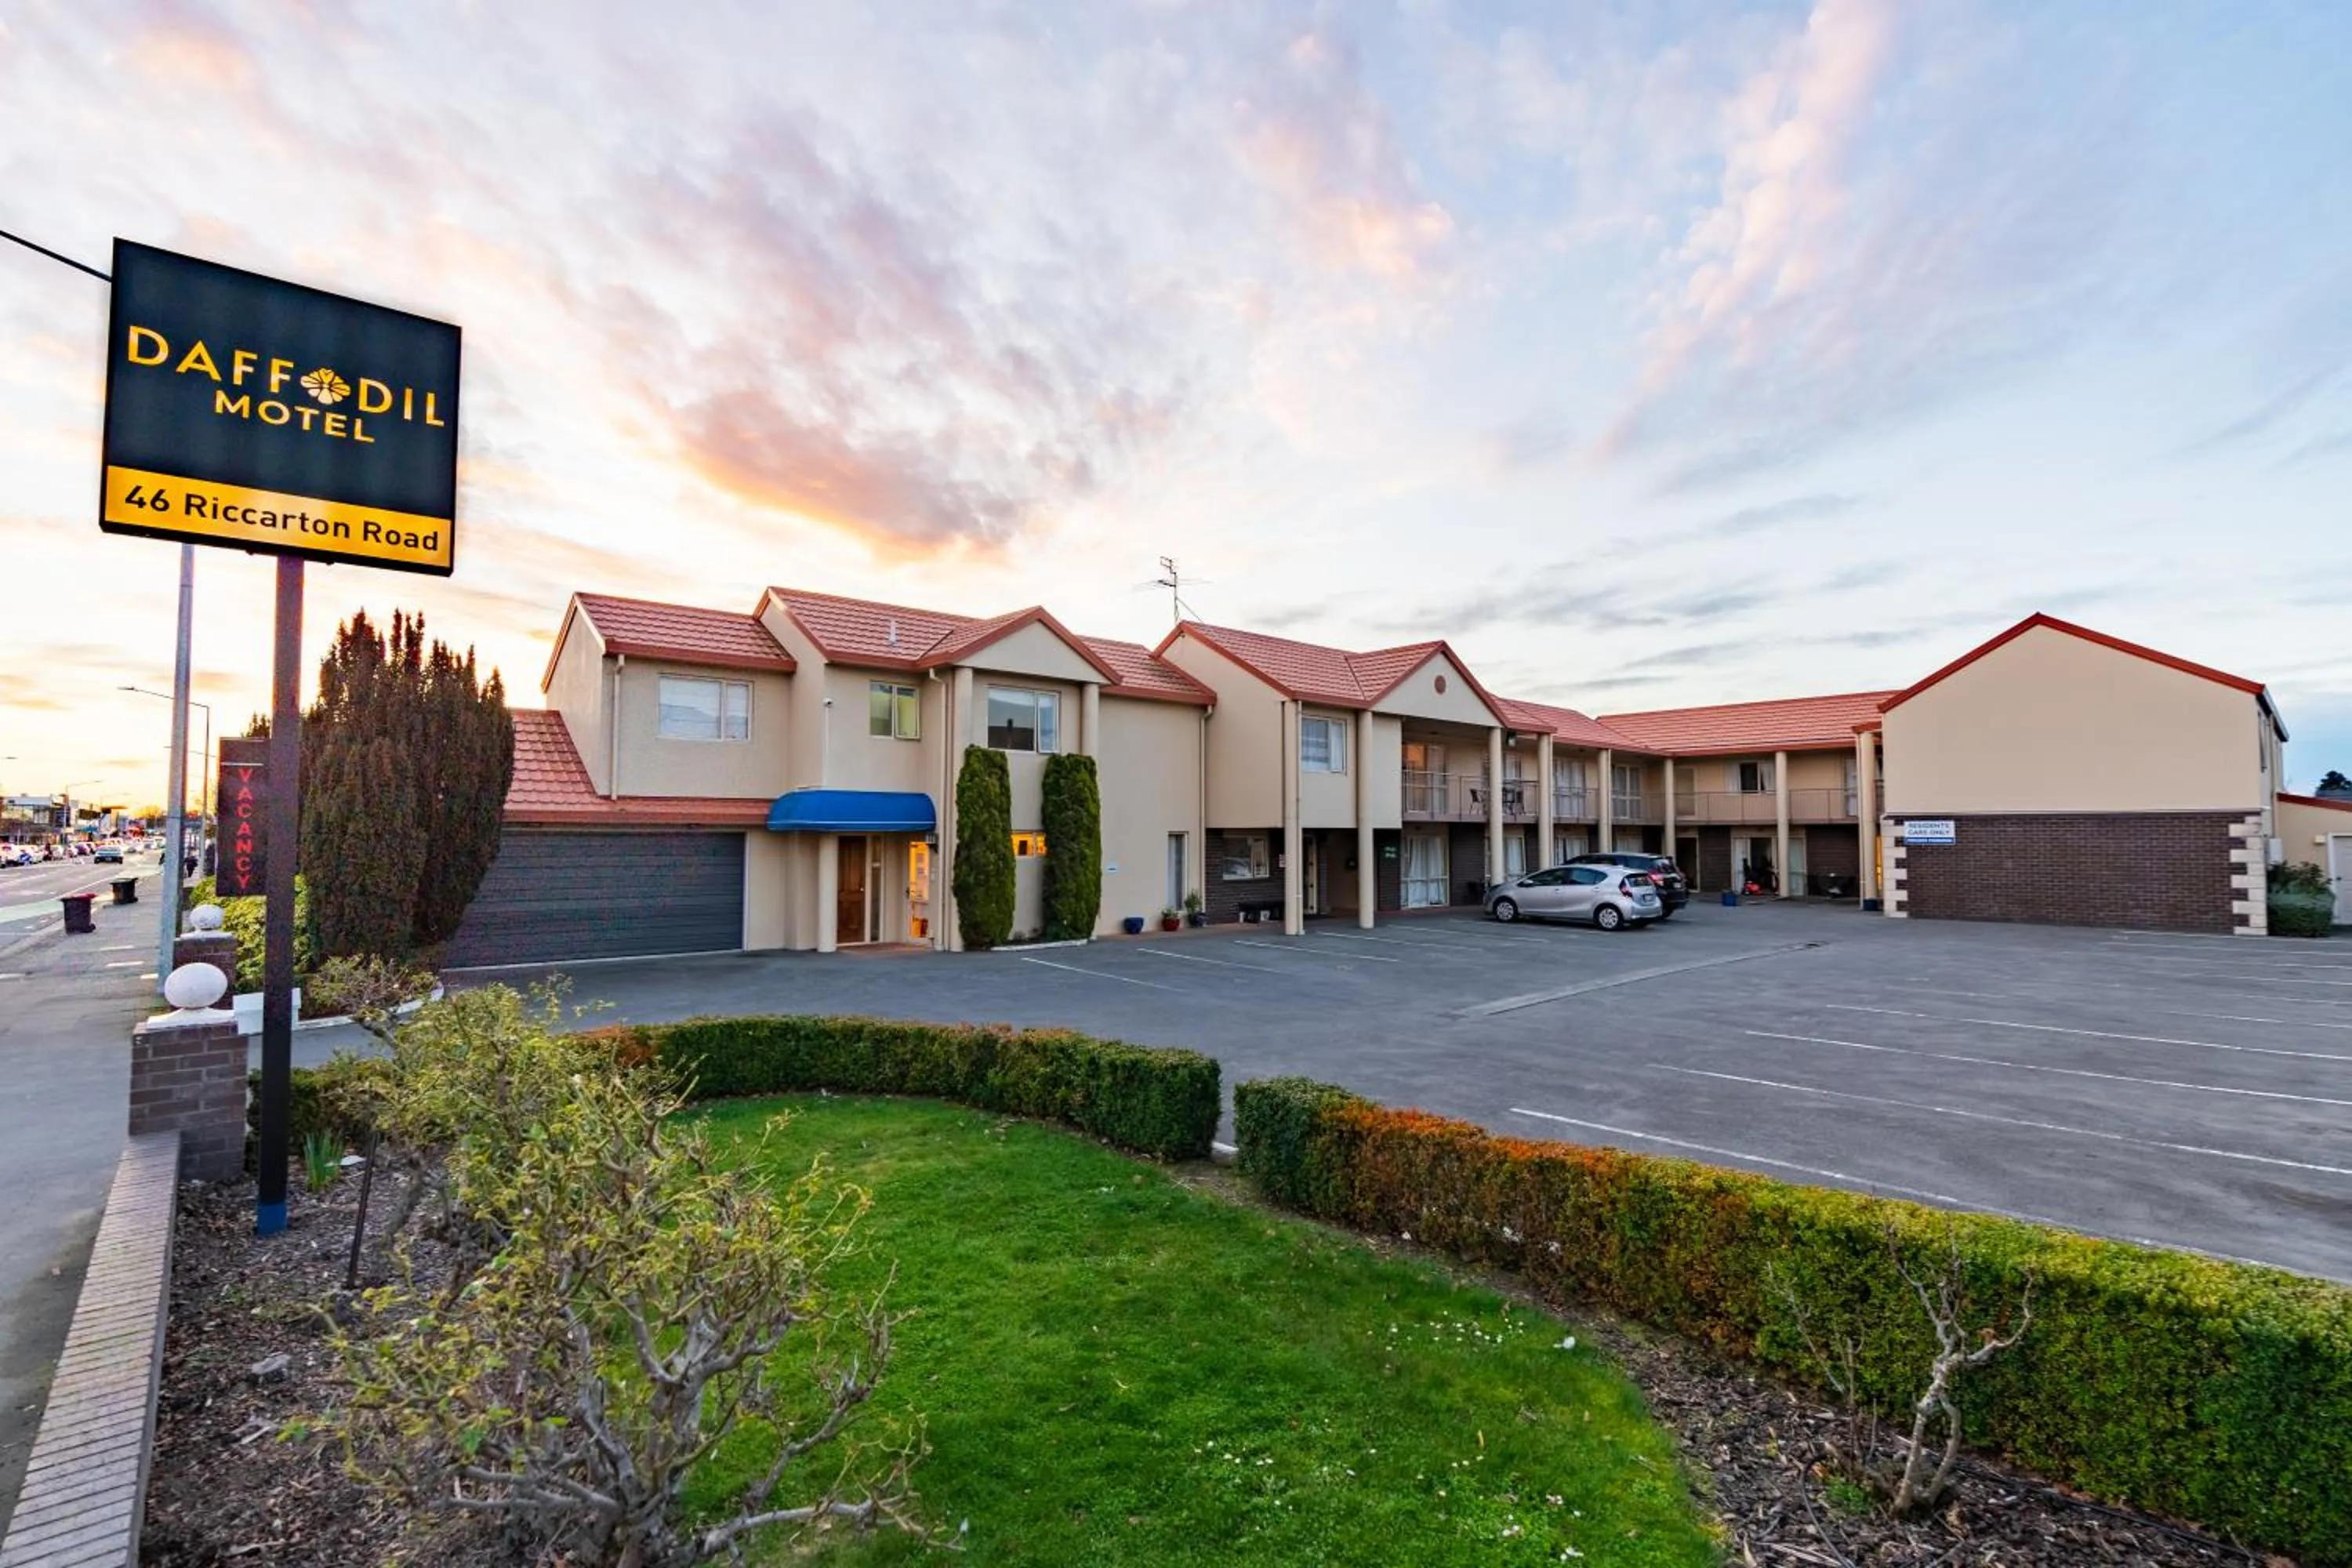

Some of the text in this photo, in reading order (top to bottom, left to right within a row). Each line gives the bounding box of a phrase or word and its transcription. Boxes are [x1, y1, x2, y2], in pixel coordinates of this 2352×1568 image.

[215, 390, 376, 443] MOTEL
[125, 485, 439, 552] 46 Riccarton Road
[237, 768, 253, 890] VACANCY
